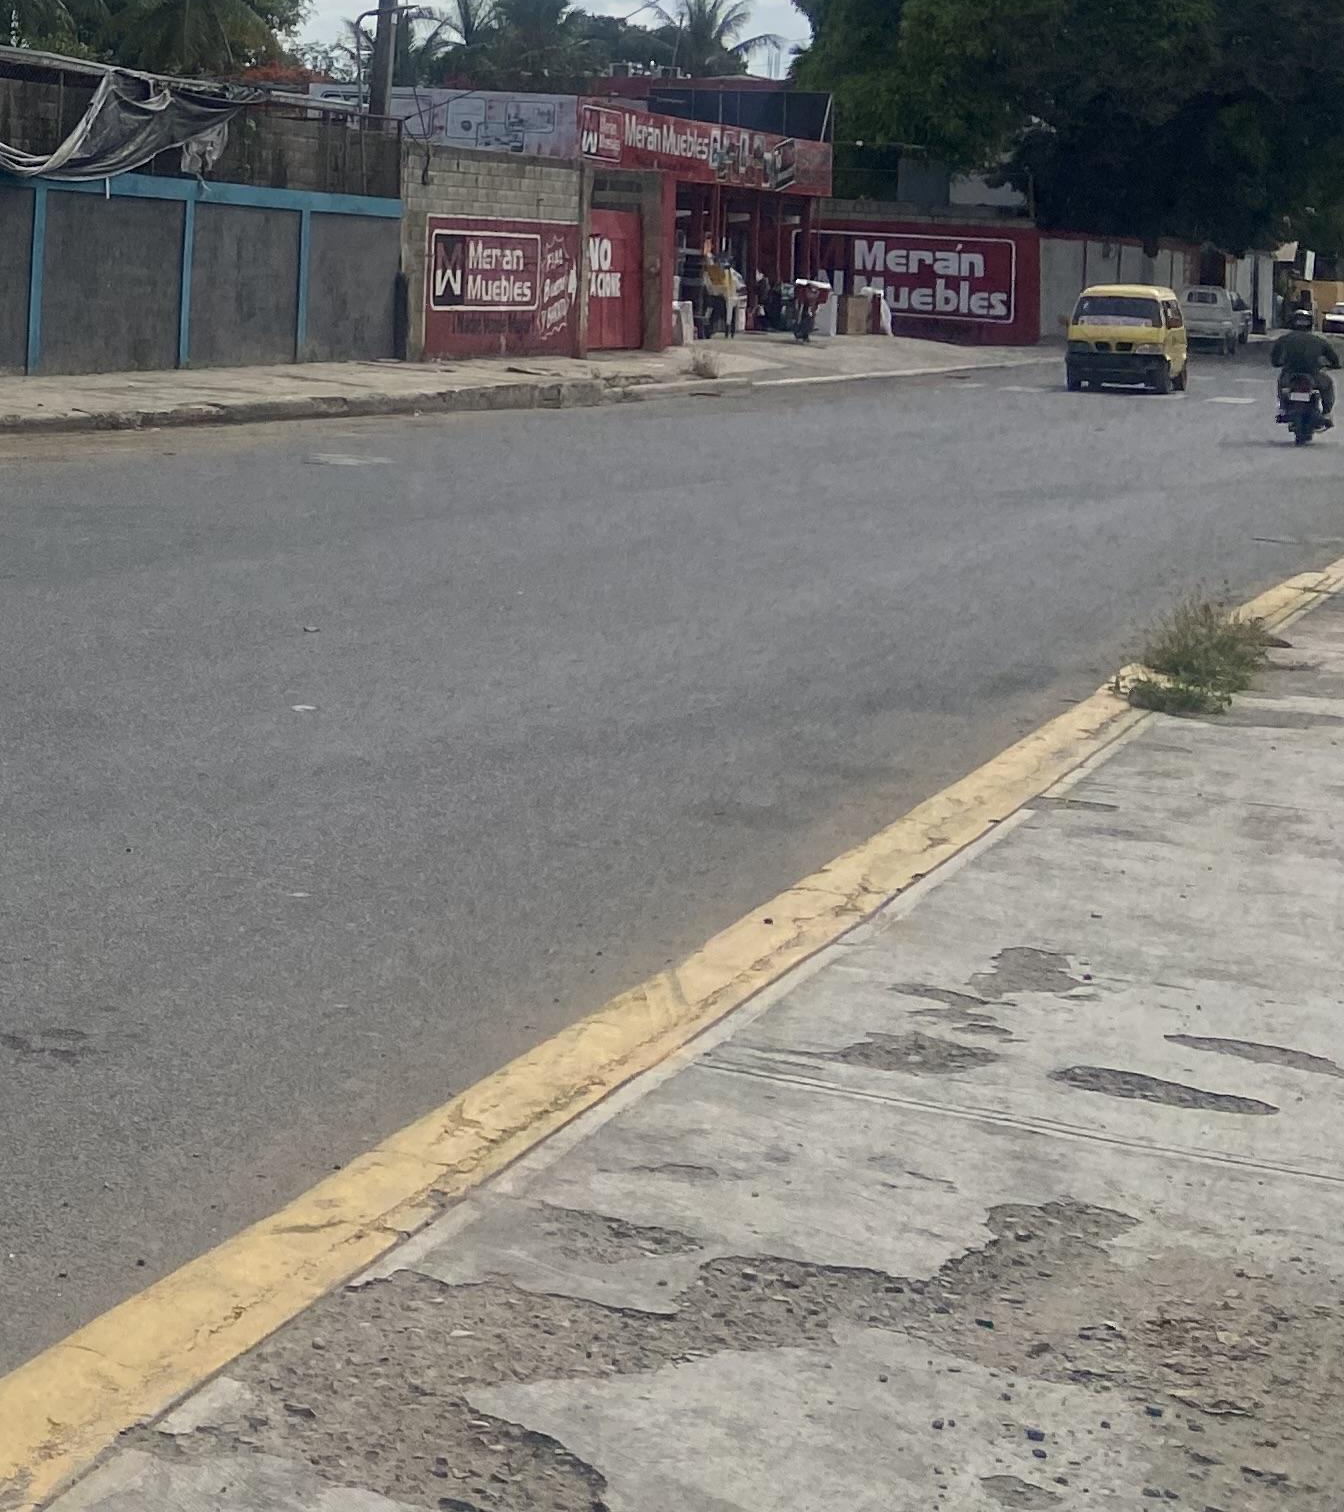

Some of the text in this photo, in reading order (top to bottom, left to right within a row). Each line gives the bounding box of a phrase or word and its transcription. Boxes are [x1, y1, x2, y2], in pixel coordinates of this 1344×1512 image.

[662, 124, 709, 161] Muebles
[854, 239, 985, 278] Merán
[467, 275, 531, 302] Muebles
